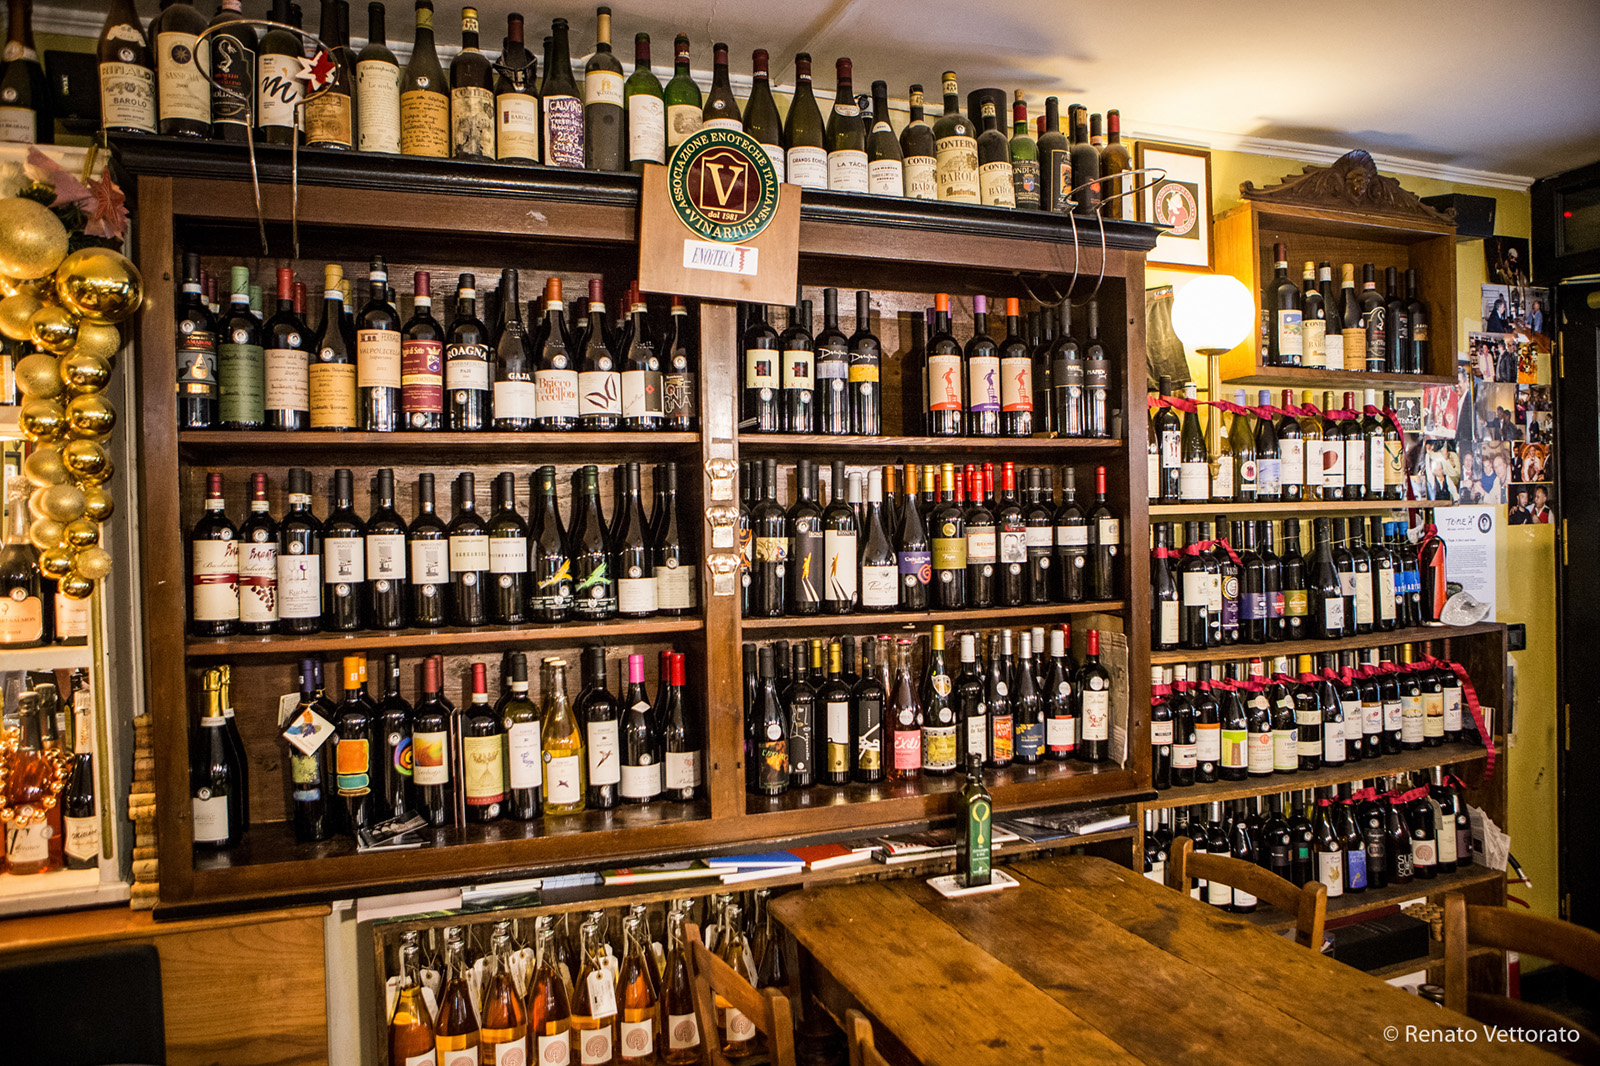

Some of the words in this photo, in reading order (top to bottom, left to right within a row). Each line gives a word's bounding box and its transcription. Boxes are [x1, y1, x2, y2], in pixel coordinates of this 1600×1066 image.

[102, 64, 155, 81] RINALDI
[113, 97, 147, 108] BAROLO
[557, 131, 579, 143] 2005
[673, 134, 709, 209] ASSOCIAZIONE
[711, 132, 768, 167] ENOTECHE
[758, 166, 775, 221] ITALIANE
[705, 162, 744, 206] V
[708, 210, 720, 219] dal
[722, 212, 738, 221] 1981
[689, 209, 757, 239] VINARIUS
[186, 339, 213, 347] AMARONE
[447, 345, 487, 361] ROAGNA
[508, 372, 531, 381] GAJA
[538, 377, 572, 389] Bricco
